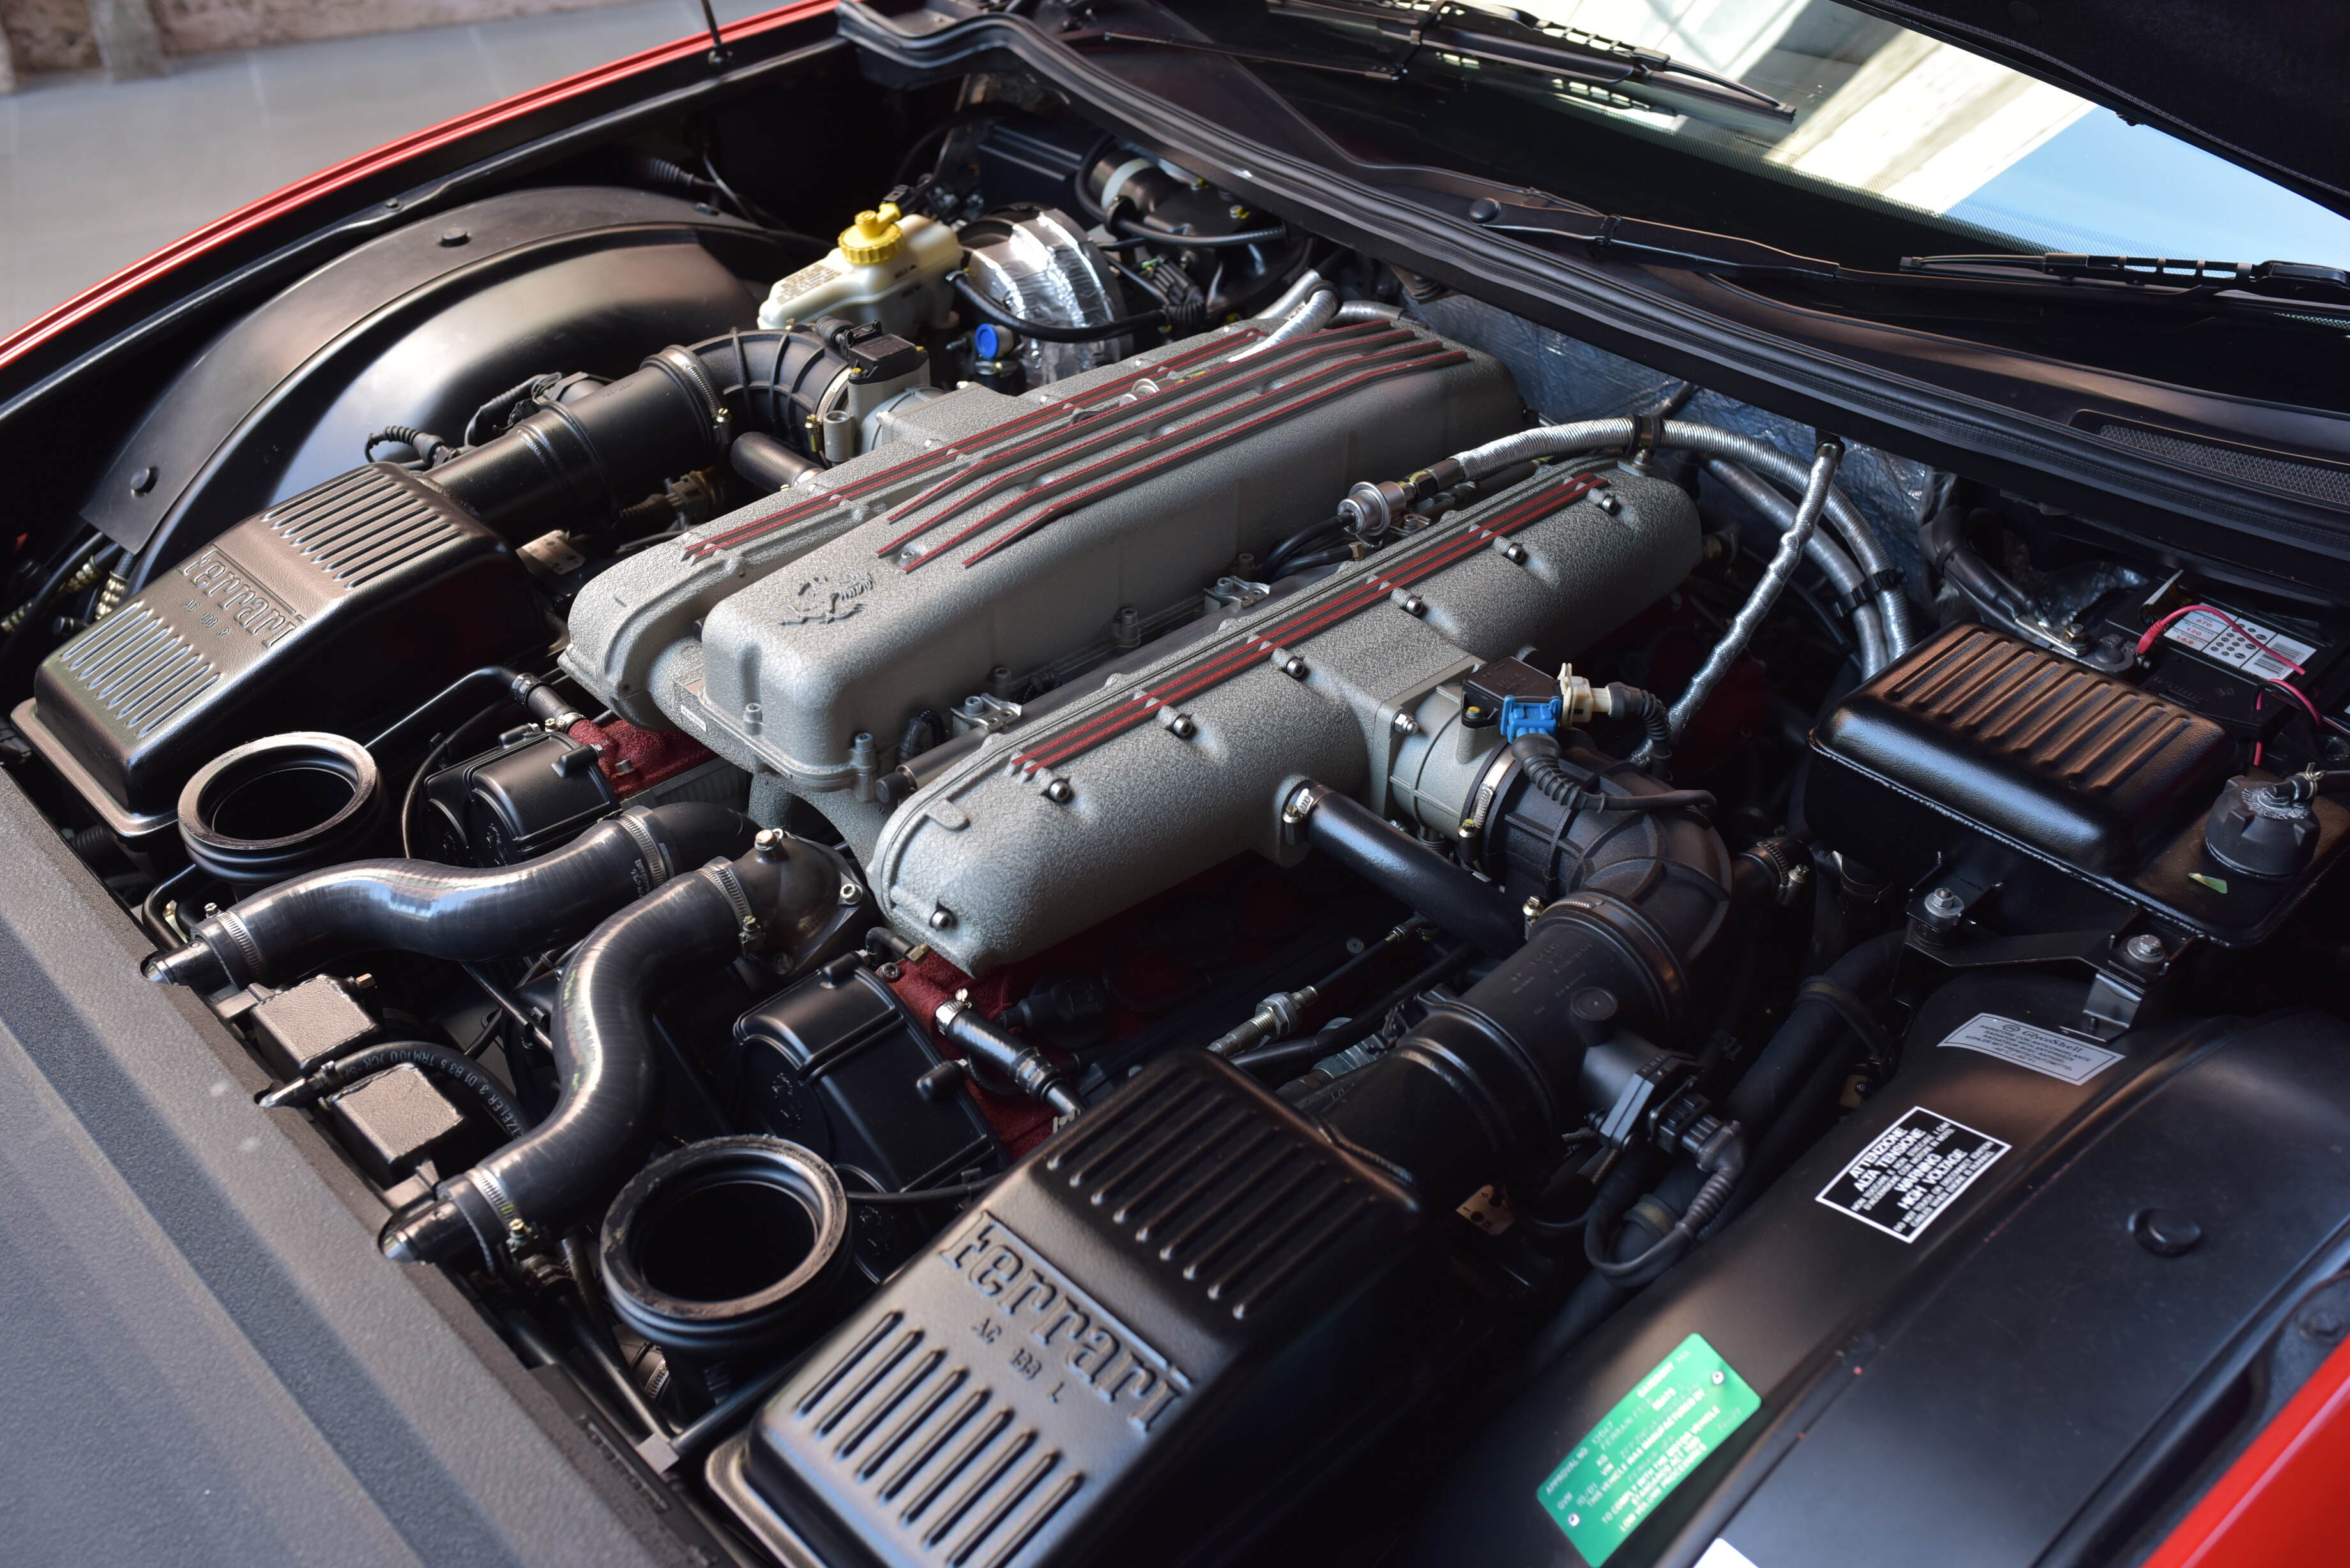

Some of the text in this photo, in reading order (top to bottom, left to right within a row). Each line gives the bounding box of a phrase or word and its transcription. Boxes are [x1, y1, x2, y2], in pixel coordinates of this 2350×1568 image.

[176, 543, 306, 649] Ferrari
[2022, 1031, 2085, 1052] GlycoShell
[1849, 1126, 1908, 1179] ATTENZIONE
[1854, 1128, 1926, 1191] ALTA TENSIONE
[1894, 1154, 1942, 1192] WARNING
[1898, 1149, 1967, 1209] HIGH VOLTAGE
[938, 1209, 1194, 1432] Ferrari
